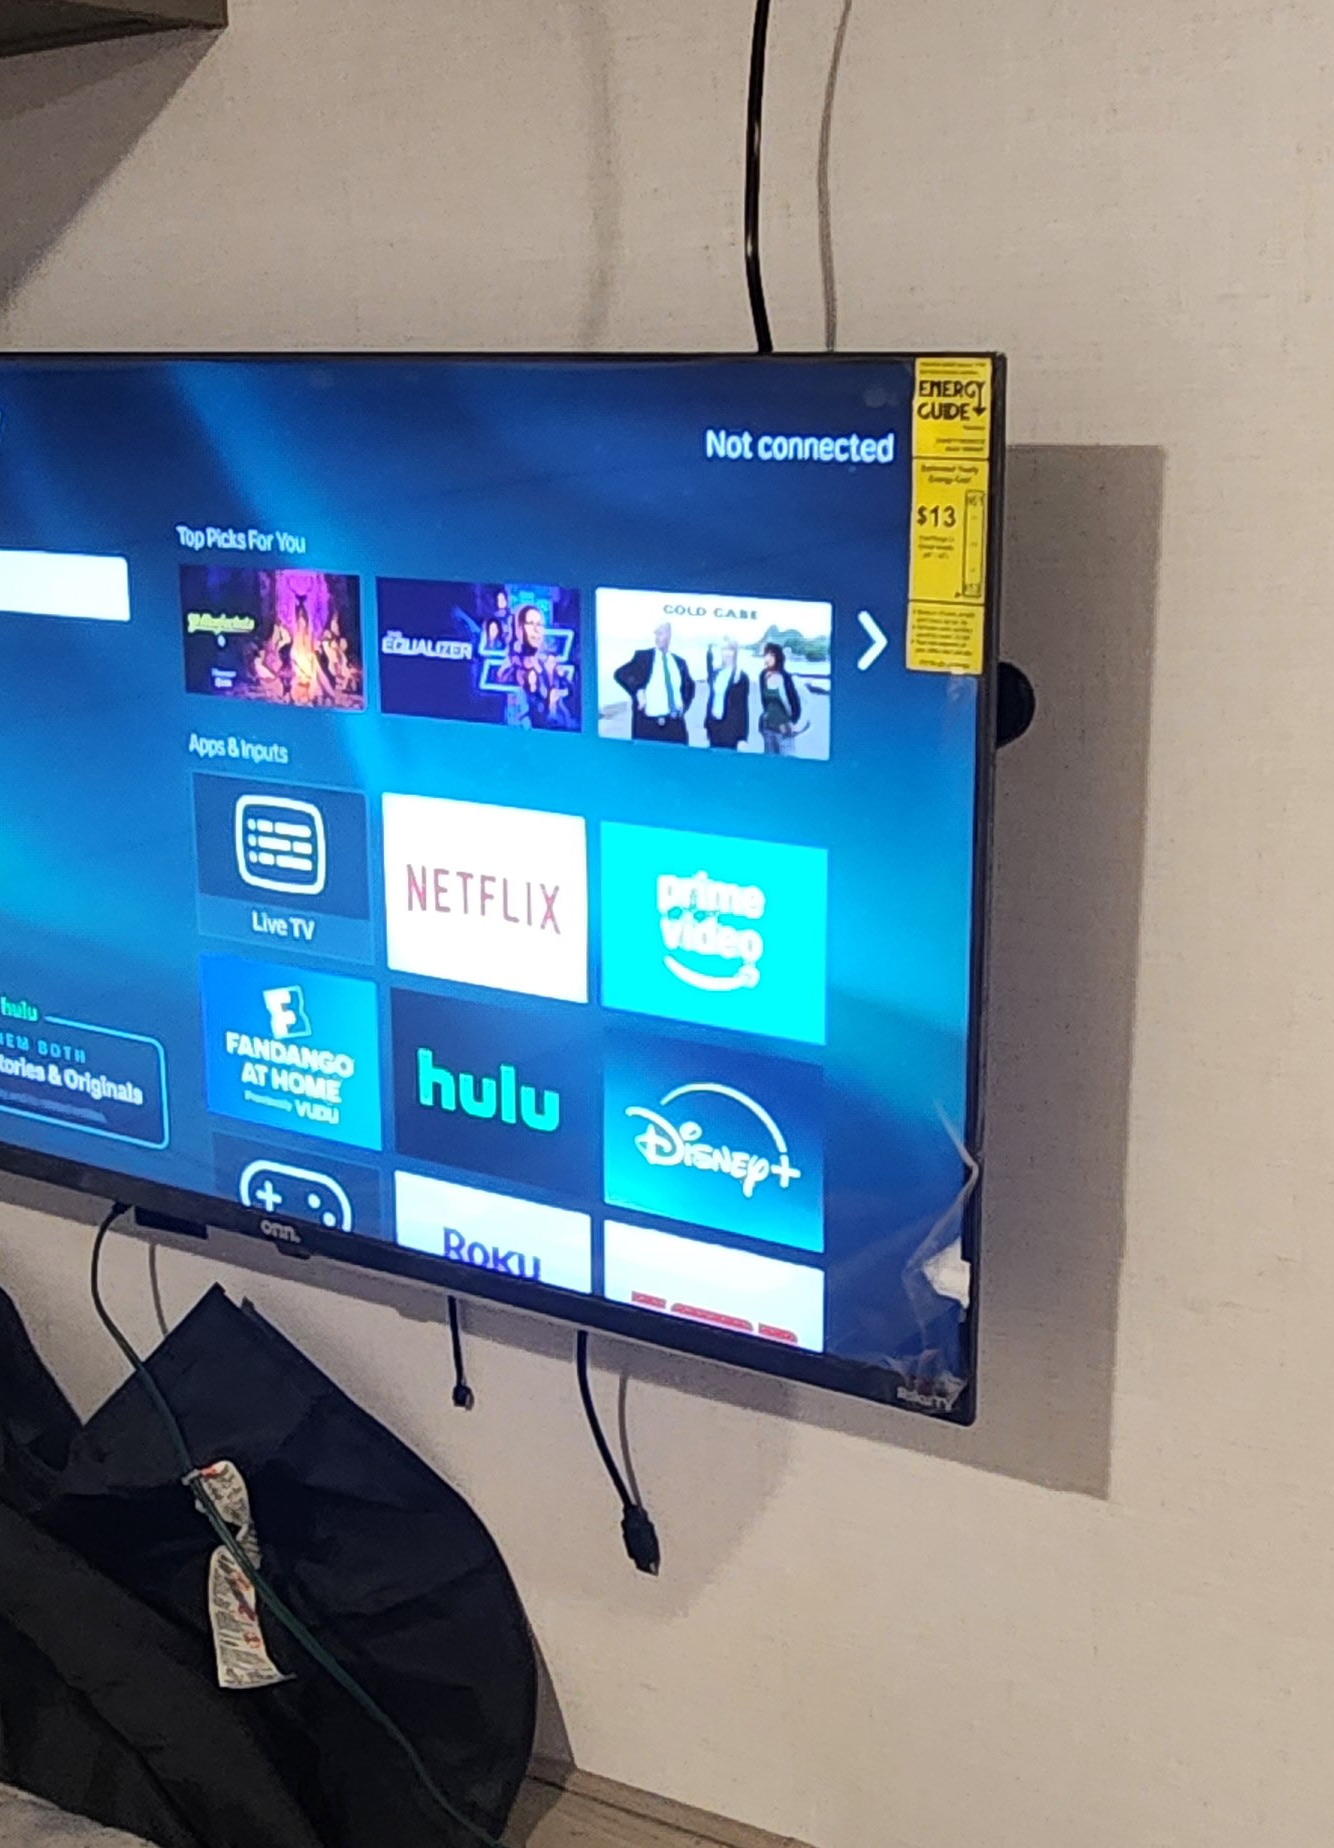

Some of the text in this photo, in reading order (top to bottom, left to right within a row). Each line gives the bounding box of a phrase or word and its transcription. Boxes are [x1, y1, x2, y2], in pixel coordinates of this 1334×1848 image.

[918, 380, 986, 406] ENERGY
[917, 402, 971, 421] GUIDE
[706, 429, 895, 463] Not connected
[916, 505, 956, 527] $13
[176, 525, 307, 554] Top Picks For You
[663, 604, 706, 619] COLD
[381, 636, 473, 661] EQUALIZER
[188, 733, 289, 764] Apps & Inputs
[405, 863, 562, 935] NETFLIX
[656, 870, 767, 920] prime
[252, 910, 315, 942] Live TV
[660, 912, 764, 964] video
[37, 1040, 86, 1065] BOTH
[225, 1030, 355, 1079] FANDANGO
[47, 1064, 63, 1087] &
[63, 1068, 144, 1106] Originals
[241, 1061, 269, 1087] AT
[270, 1066, 343, 1105] HOME
[417, 1046, 561, 1132] hulu
[294, 1098, 340, 1125] VUDU
[625, 1083, 801, 1199] Disney+
[260, 1219, 302, 1243] onn.
[443, 1227, 542, 1281] Roku
